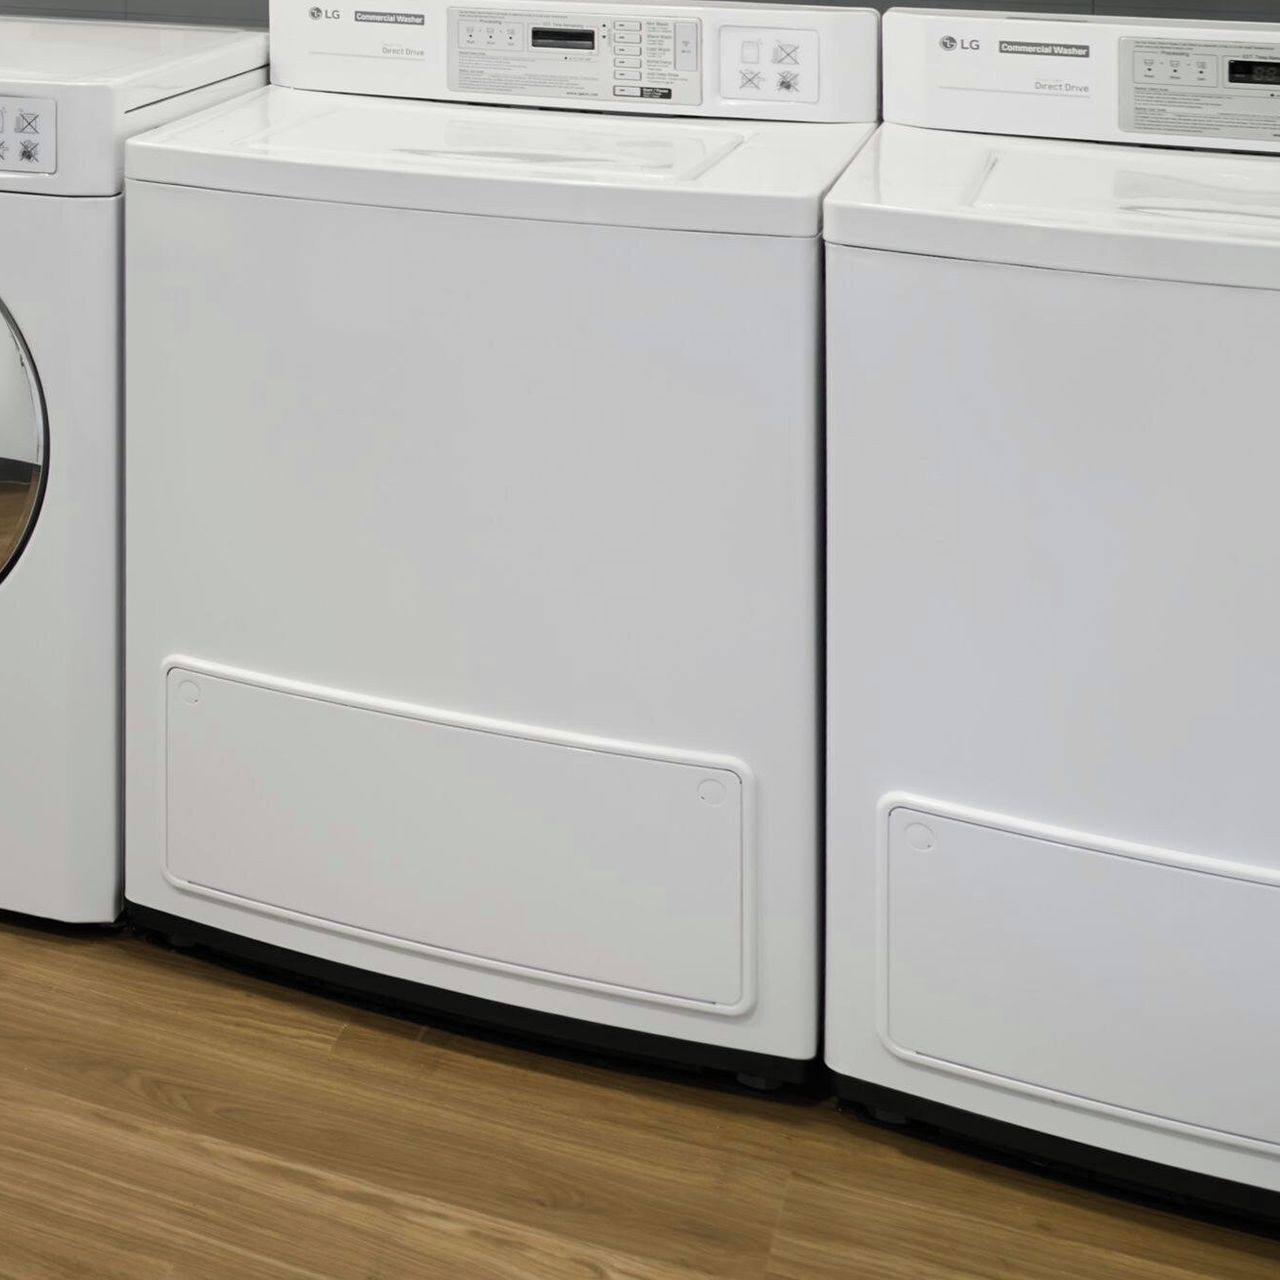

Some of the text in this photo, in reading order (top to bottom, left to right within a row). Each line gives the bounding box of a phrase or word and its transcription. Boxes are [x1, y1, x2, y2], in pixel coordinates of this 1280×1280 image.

[355, 12, 423, 24] Commercial Washer
[960, 39, 980, 50] LG
[1000, 42, 1088, 56] Commercial Washer
[382, 47, 424, 57] Direct Drive
[1035, 81, 1089, 93] Direct Drive
